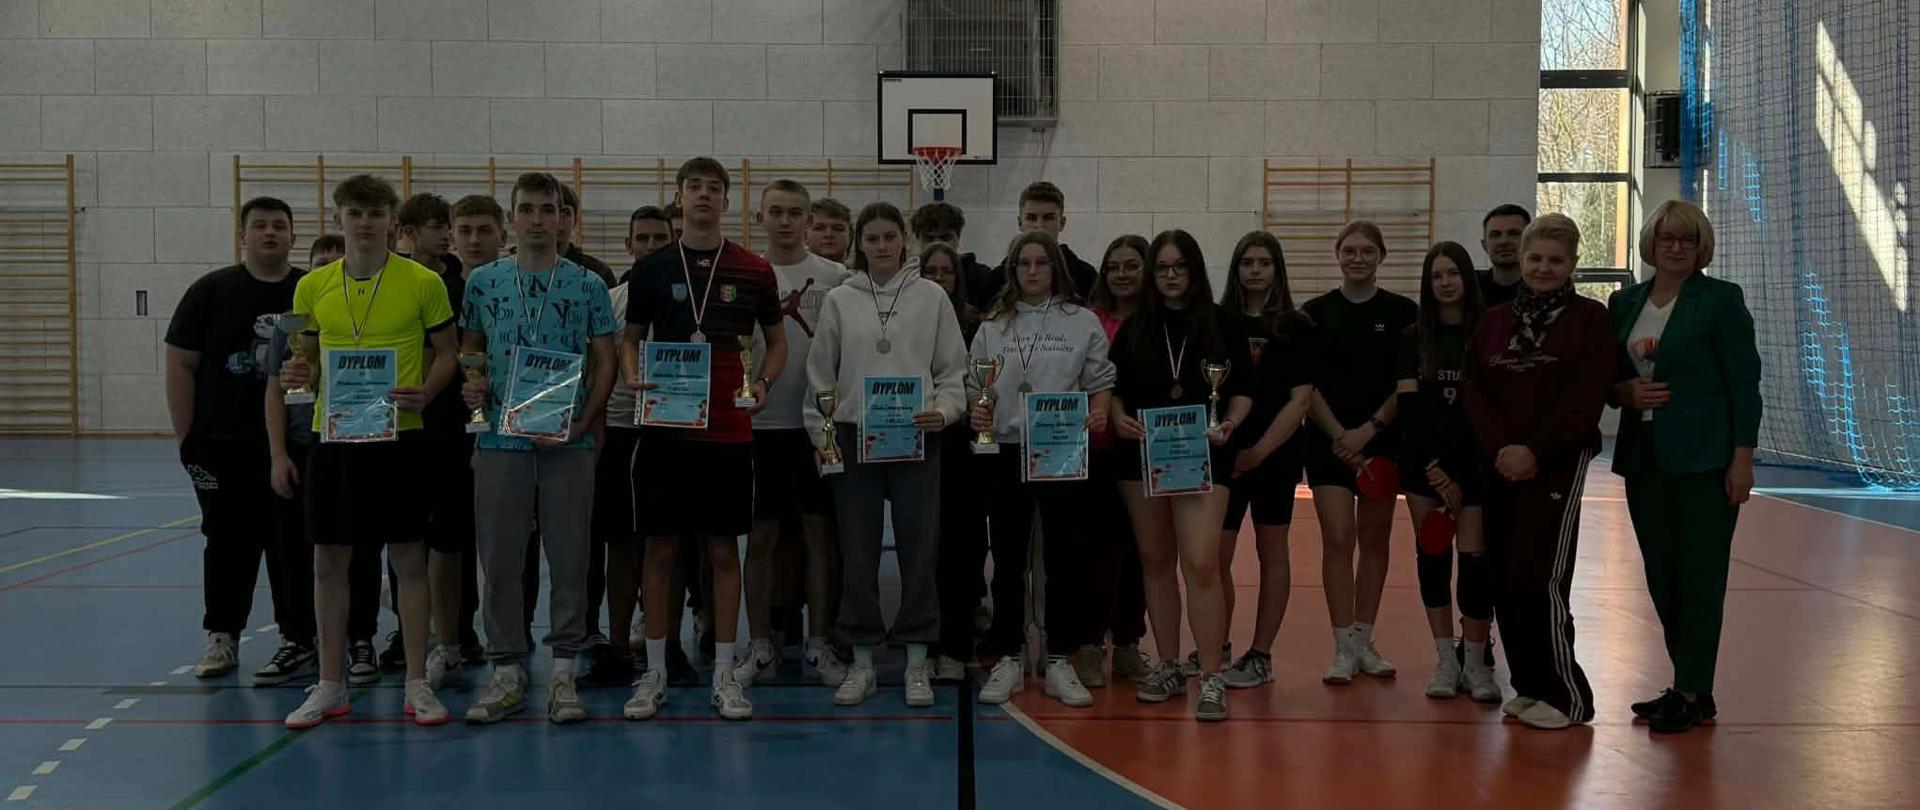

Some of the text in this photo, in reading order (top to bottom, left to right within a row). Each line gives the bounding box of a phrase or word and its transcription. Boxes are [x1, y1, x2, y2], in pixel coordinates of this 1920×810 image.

[338, 355, 387, 370] DYPLOM
[525, 354, 573, 371] DYPLOM
[656, 348, 702, 363] DYPLOM
[1437, 369, 1463, 382] STU
[872, 381, 915, 395] DYPLOM
[1443, 387, 1457, 406] 9
[1035, 398, 1079, 412] DYPLOM
[1154, 411, 1197, 427] DYPLOM
